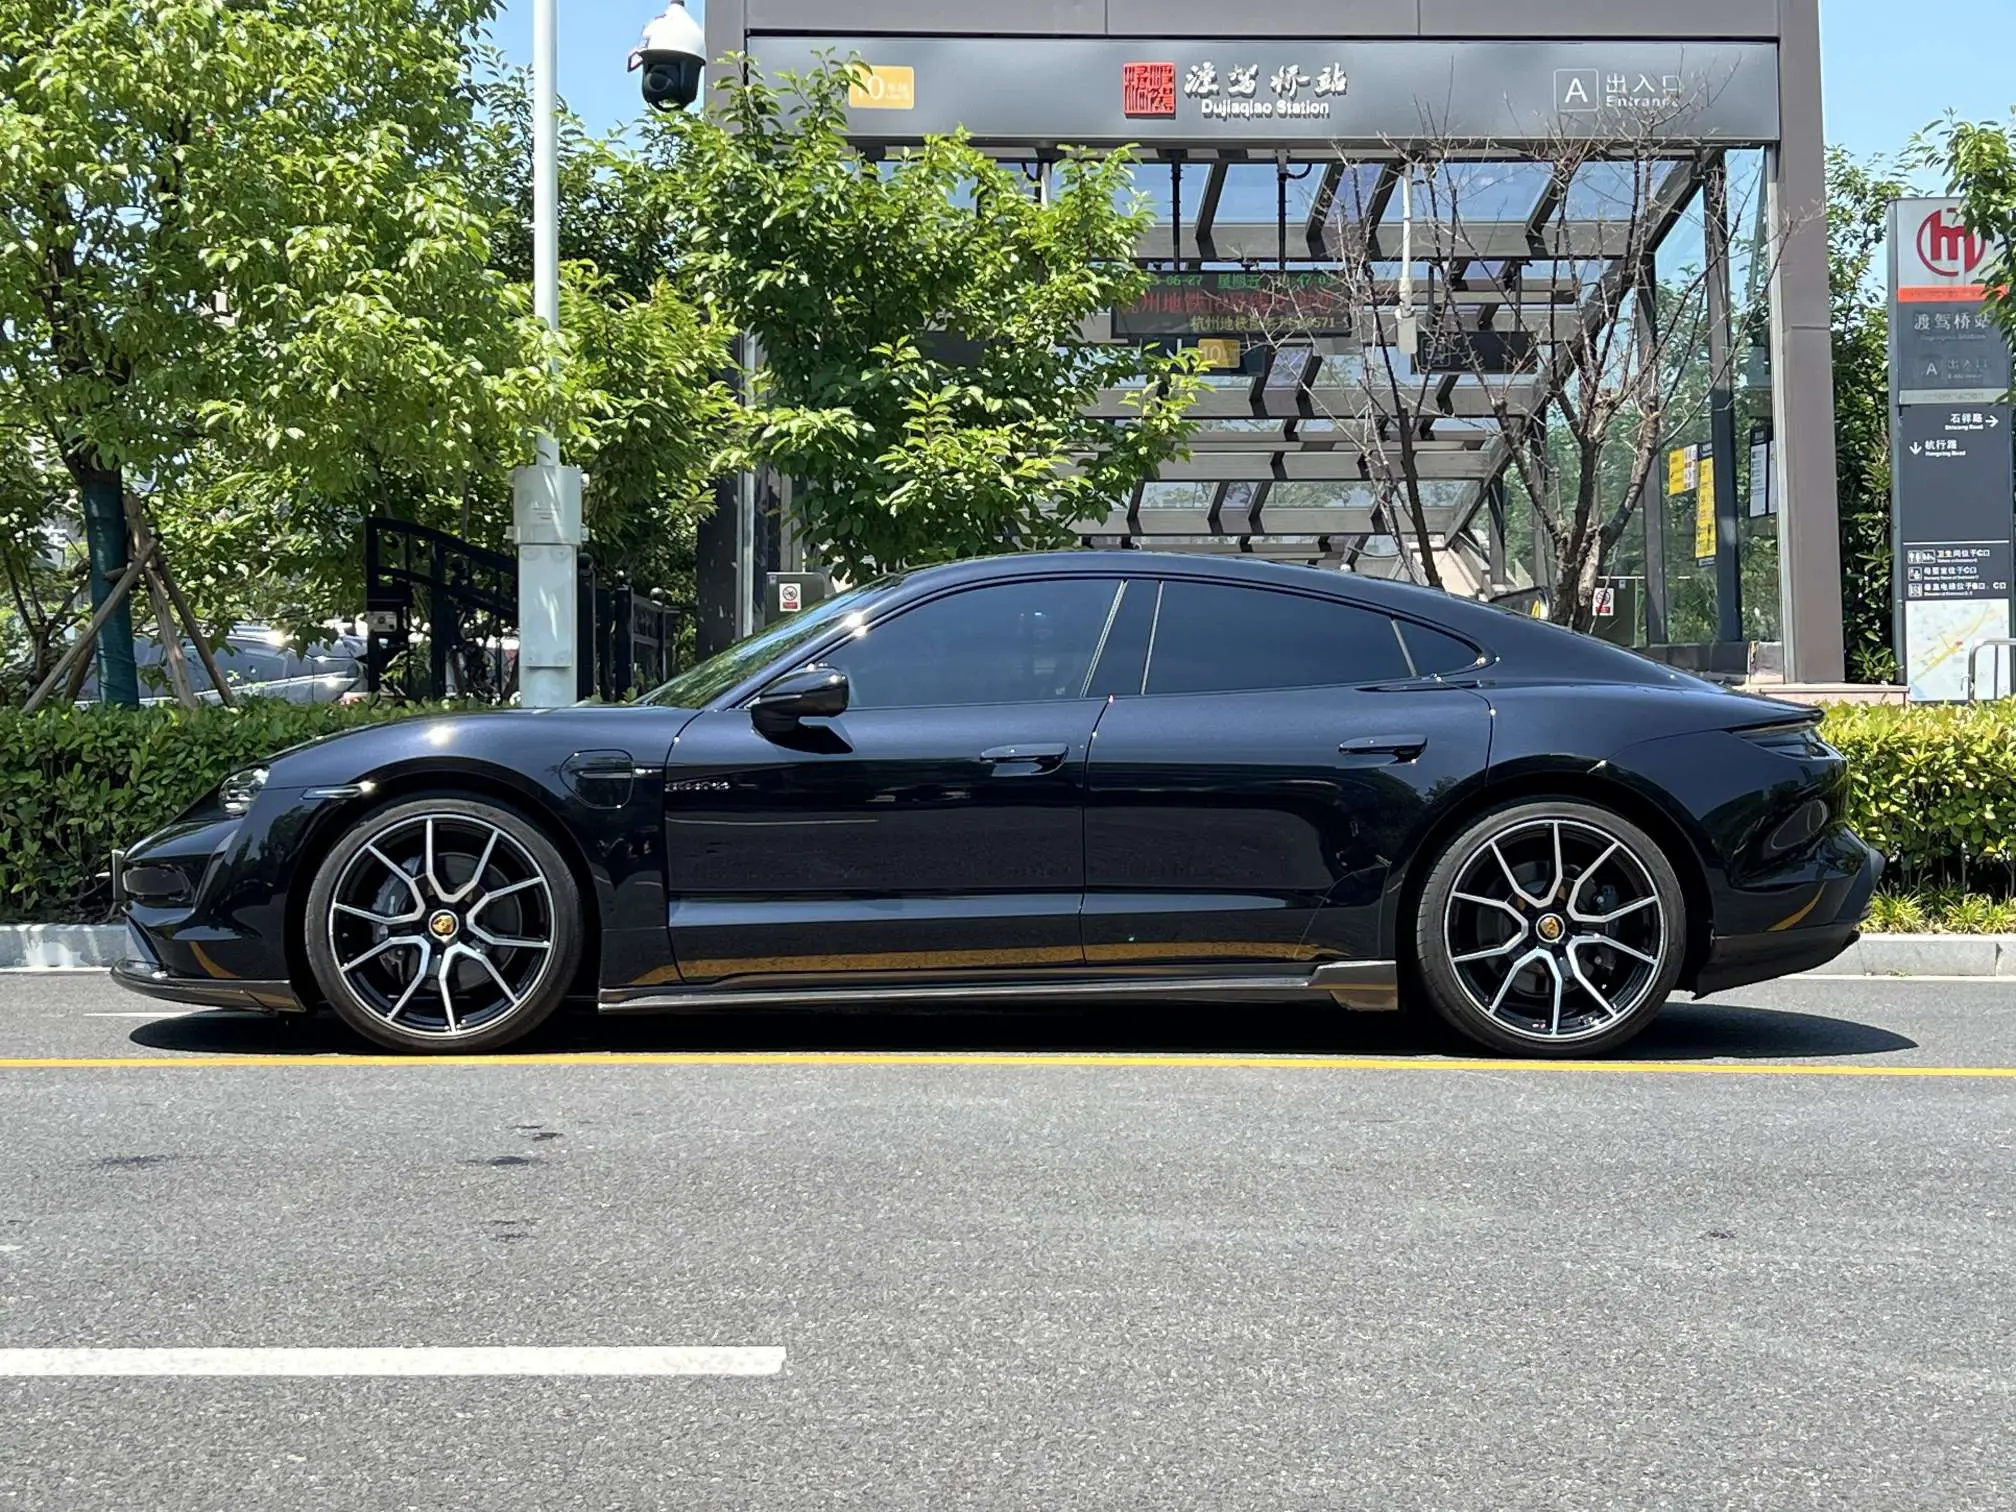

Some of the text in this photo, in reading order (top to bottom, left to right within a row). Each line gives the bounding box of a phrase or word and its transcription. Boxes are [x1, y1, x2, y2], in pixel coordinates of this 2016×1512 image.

[1184, 61, 1348, 97] 渡驾桥站
[1605, 73, 1681, 94] 出入口
[1564, 77, 1589, 103] A
[1201, 100, 1330, 117] Dujiaqiao Station
[1926, 362, 1938, 376] A
